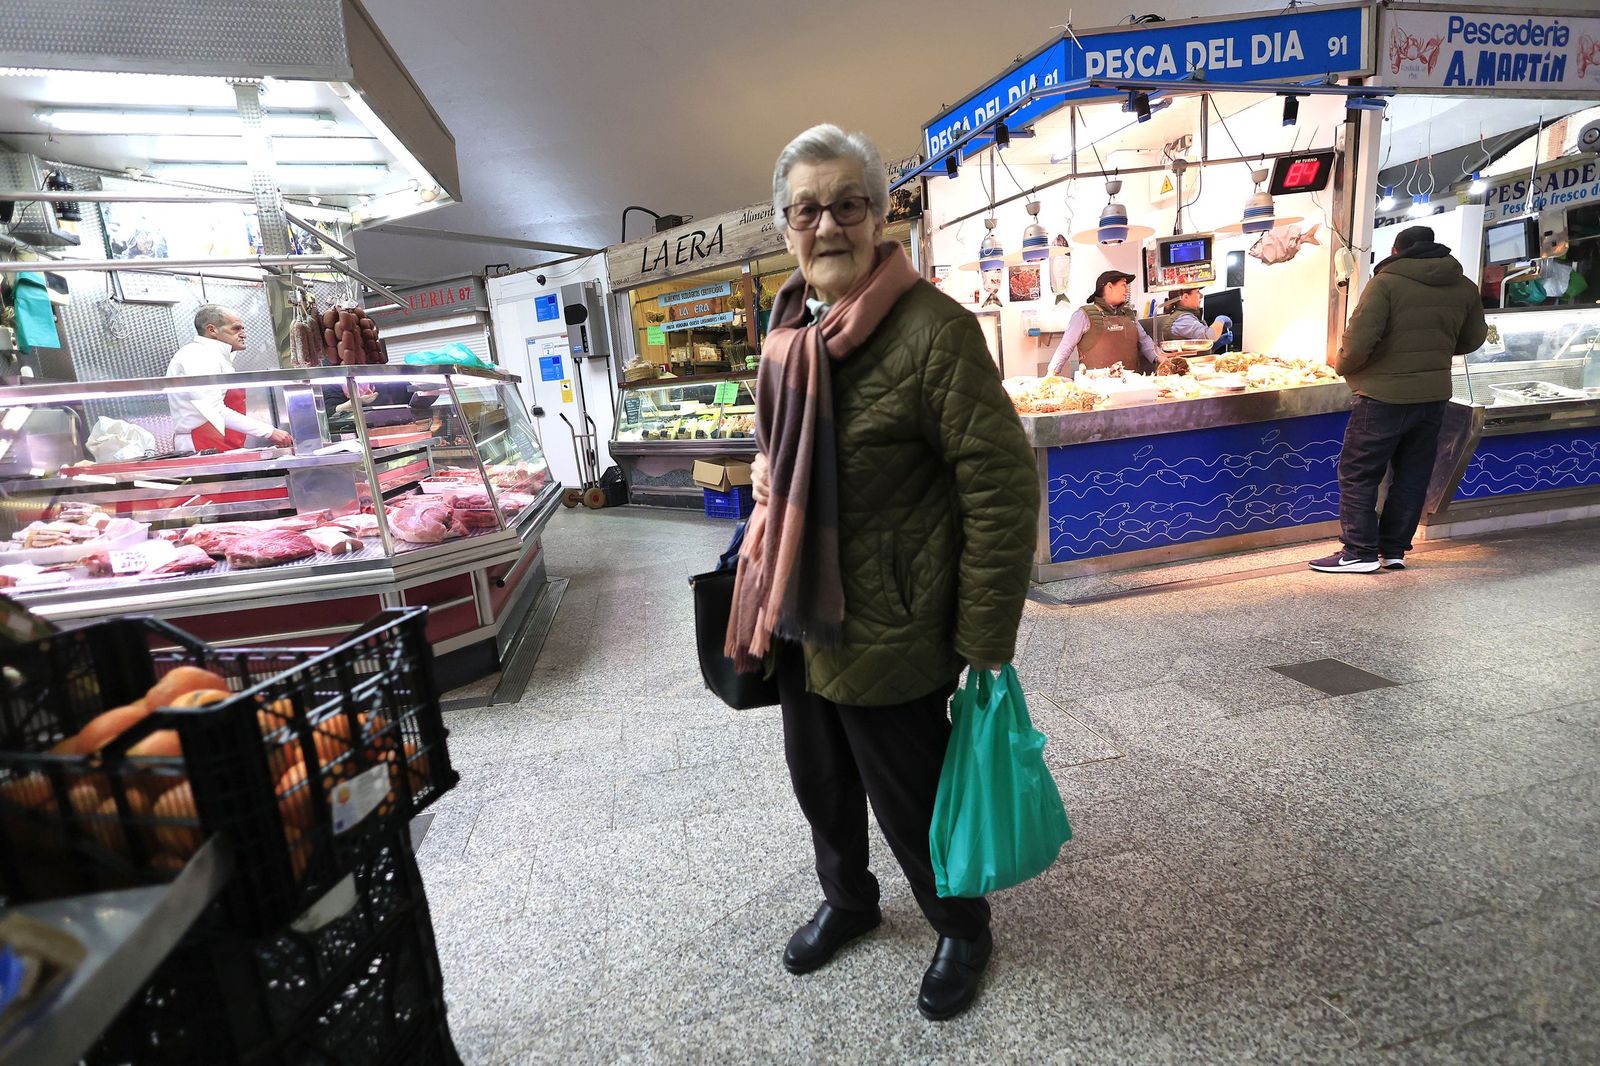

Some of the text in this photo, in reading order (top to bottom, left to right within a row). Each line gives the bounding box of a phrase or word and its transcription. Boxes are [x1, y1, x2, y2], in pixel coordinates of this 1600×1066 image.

[1086, 30, 1347, 79] PESCA DEL DIA 91
[1283, 160, 1320, 188] 84
[1485, 163, 1600, 206] PESCADE
[1503, 196, 1547, 215] Pescdo
[1551, 188, 1587, 205] fresco
[1591, 183, 1600, 196] d
[739, 205, 775, 225] Aliment
[641, 223, 724, 273] LA ERA
[458, 286, 471, 301] 87
[679, 303, 710, 316] LA ERA
